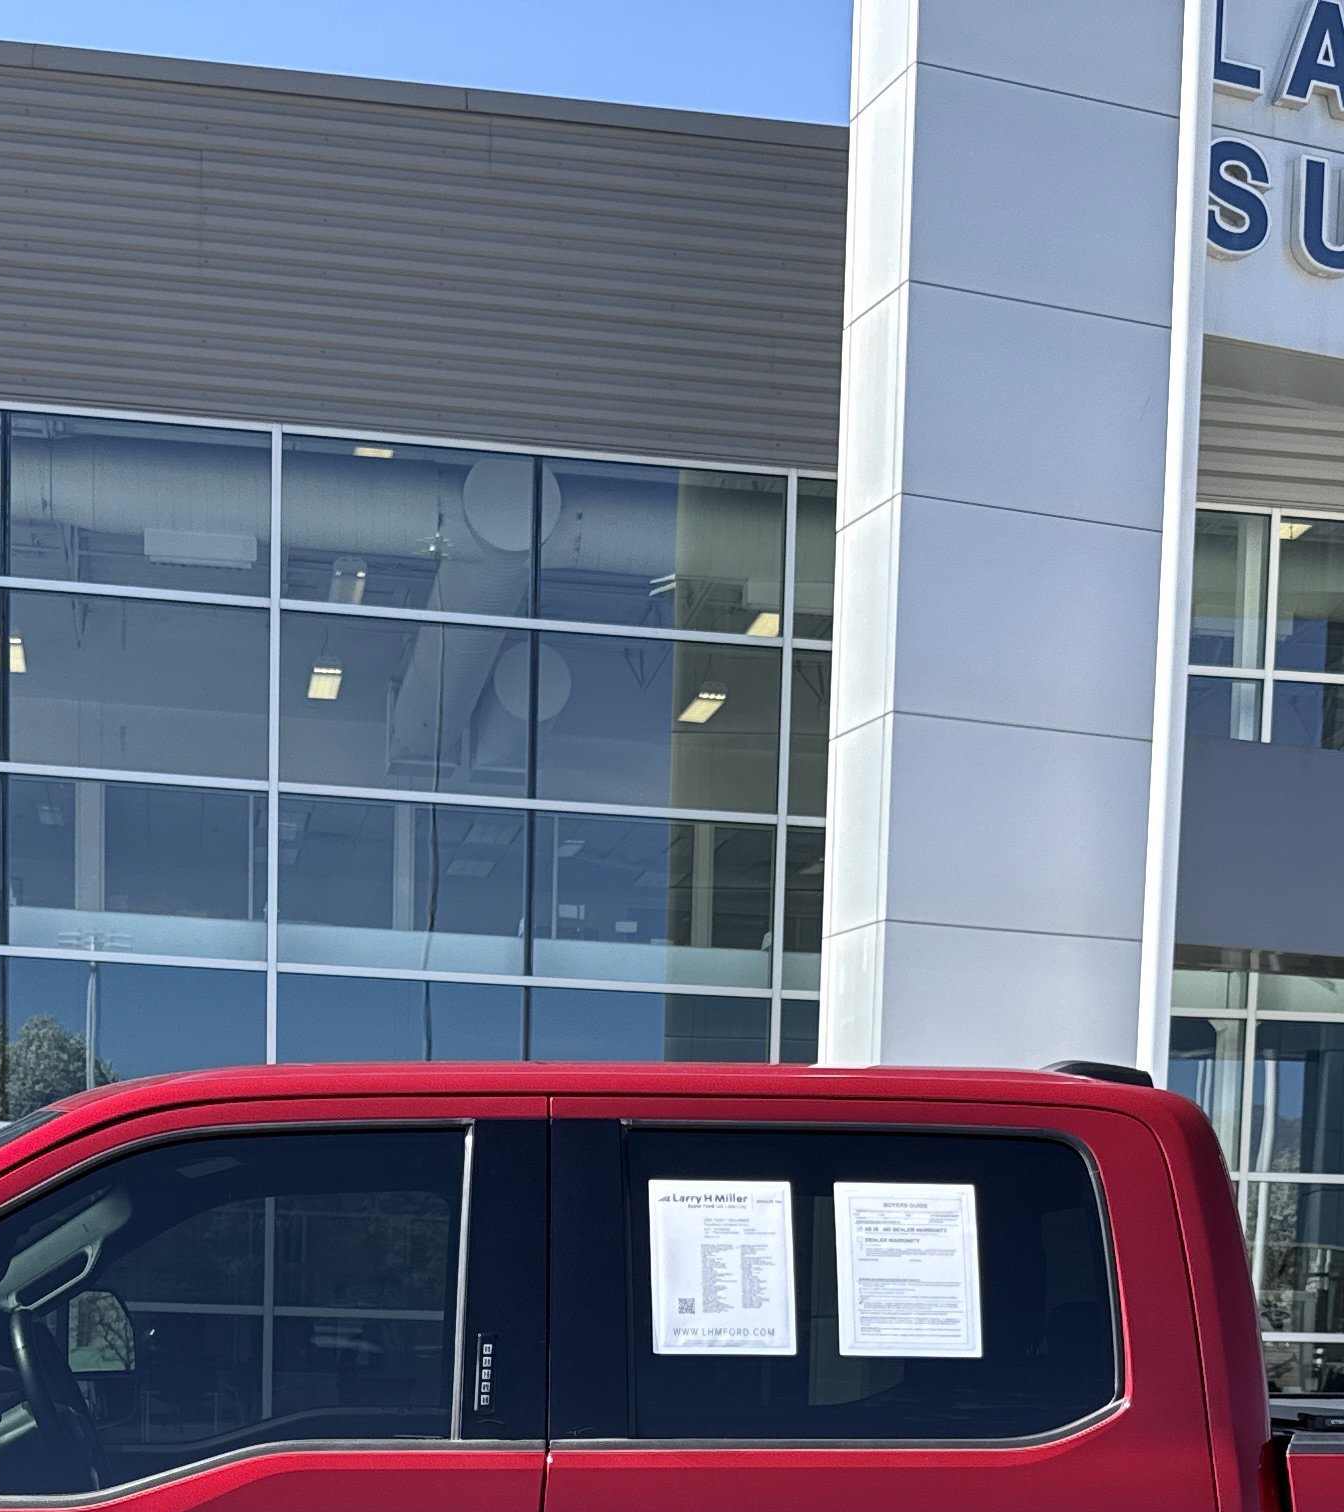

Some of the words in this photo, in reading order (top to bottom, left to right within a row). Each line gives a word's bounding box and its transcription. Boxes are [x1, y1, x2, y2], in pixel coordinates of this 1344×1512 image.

[673, 1193, 702, 1204] Larry
[704, 1193, 713, 1202] H
[715, 1193, 748, 1203] Miller
